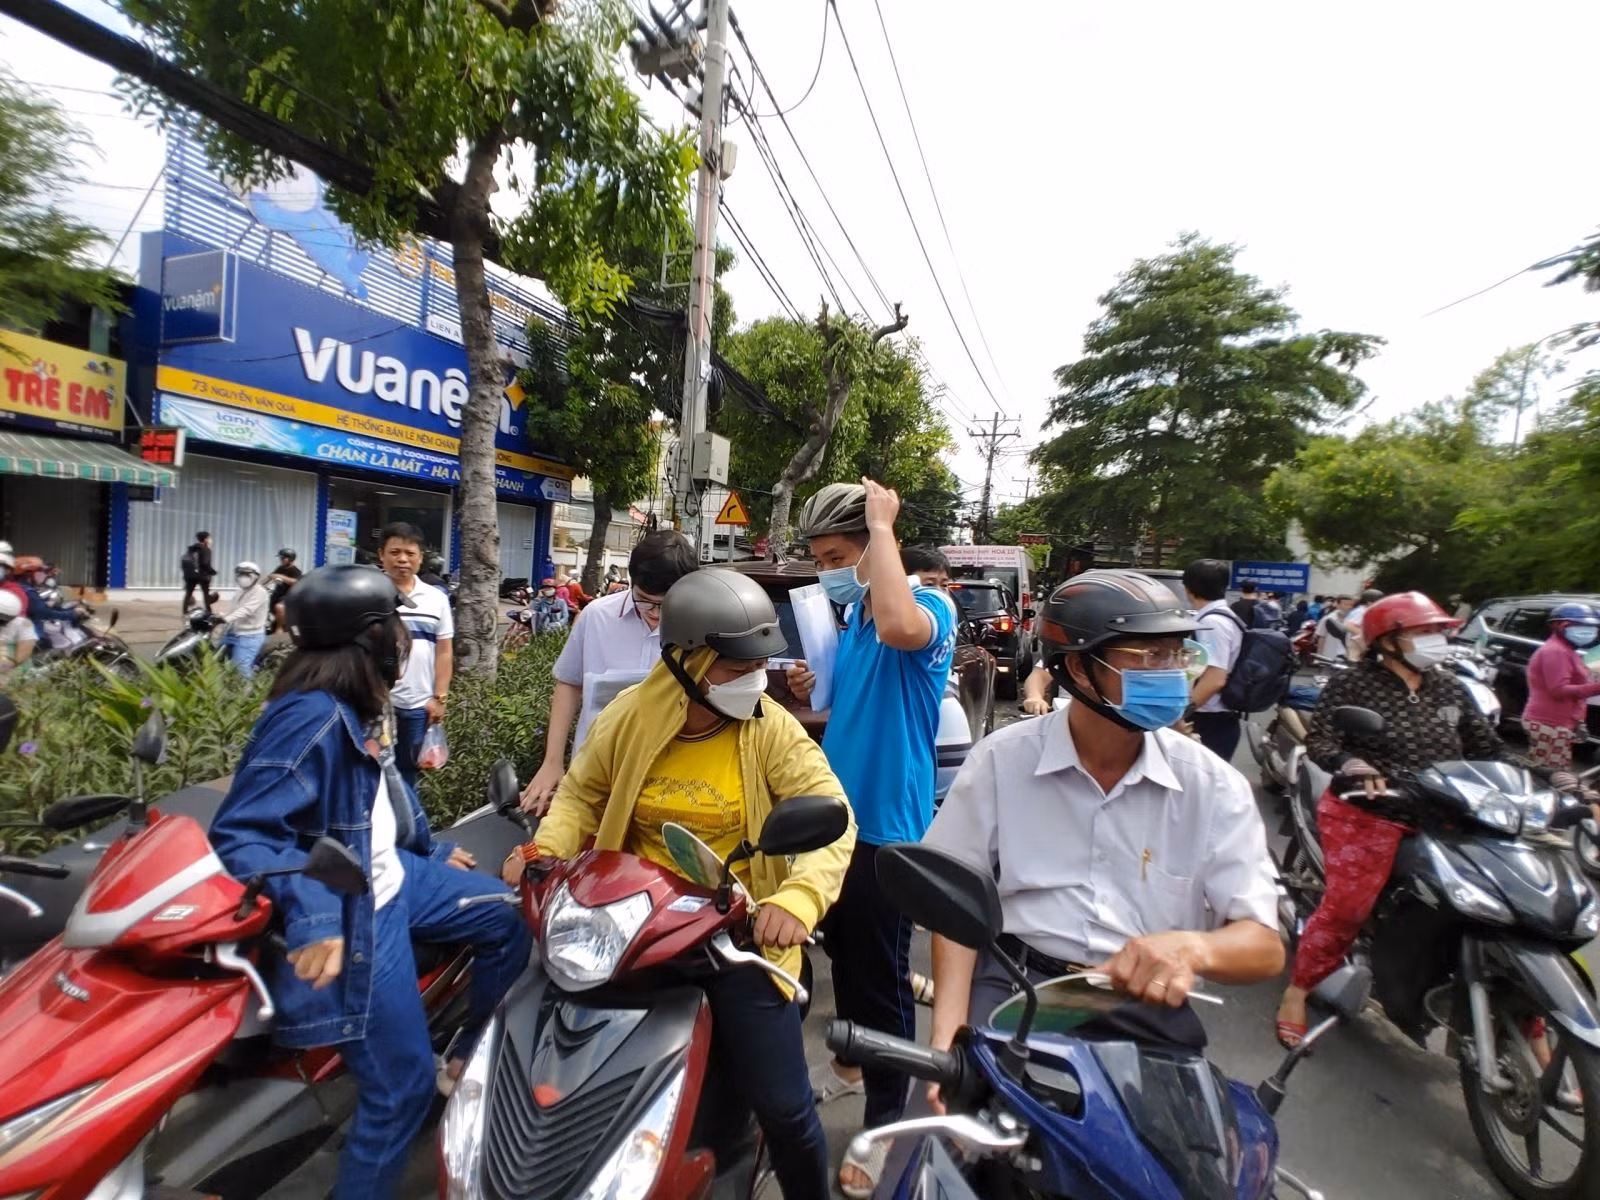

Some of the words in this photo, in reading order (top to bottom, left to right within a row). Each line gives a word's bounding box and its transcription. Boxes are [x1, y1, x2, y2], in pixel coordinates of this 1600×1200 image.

[192, 379, 208, 392] 73
[67, 381, 111, 421] EM
[496, 478, 525, 491] HANH
